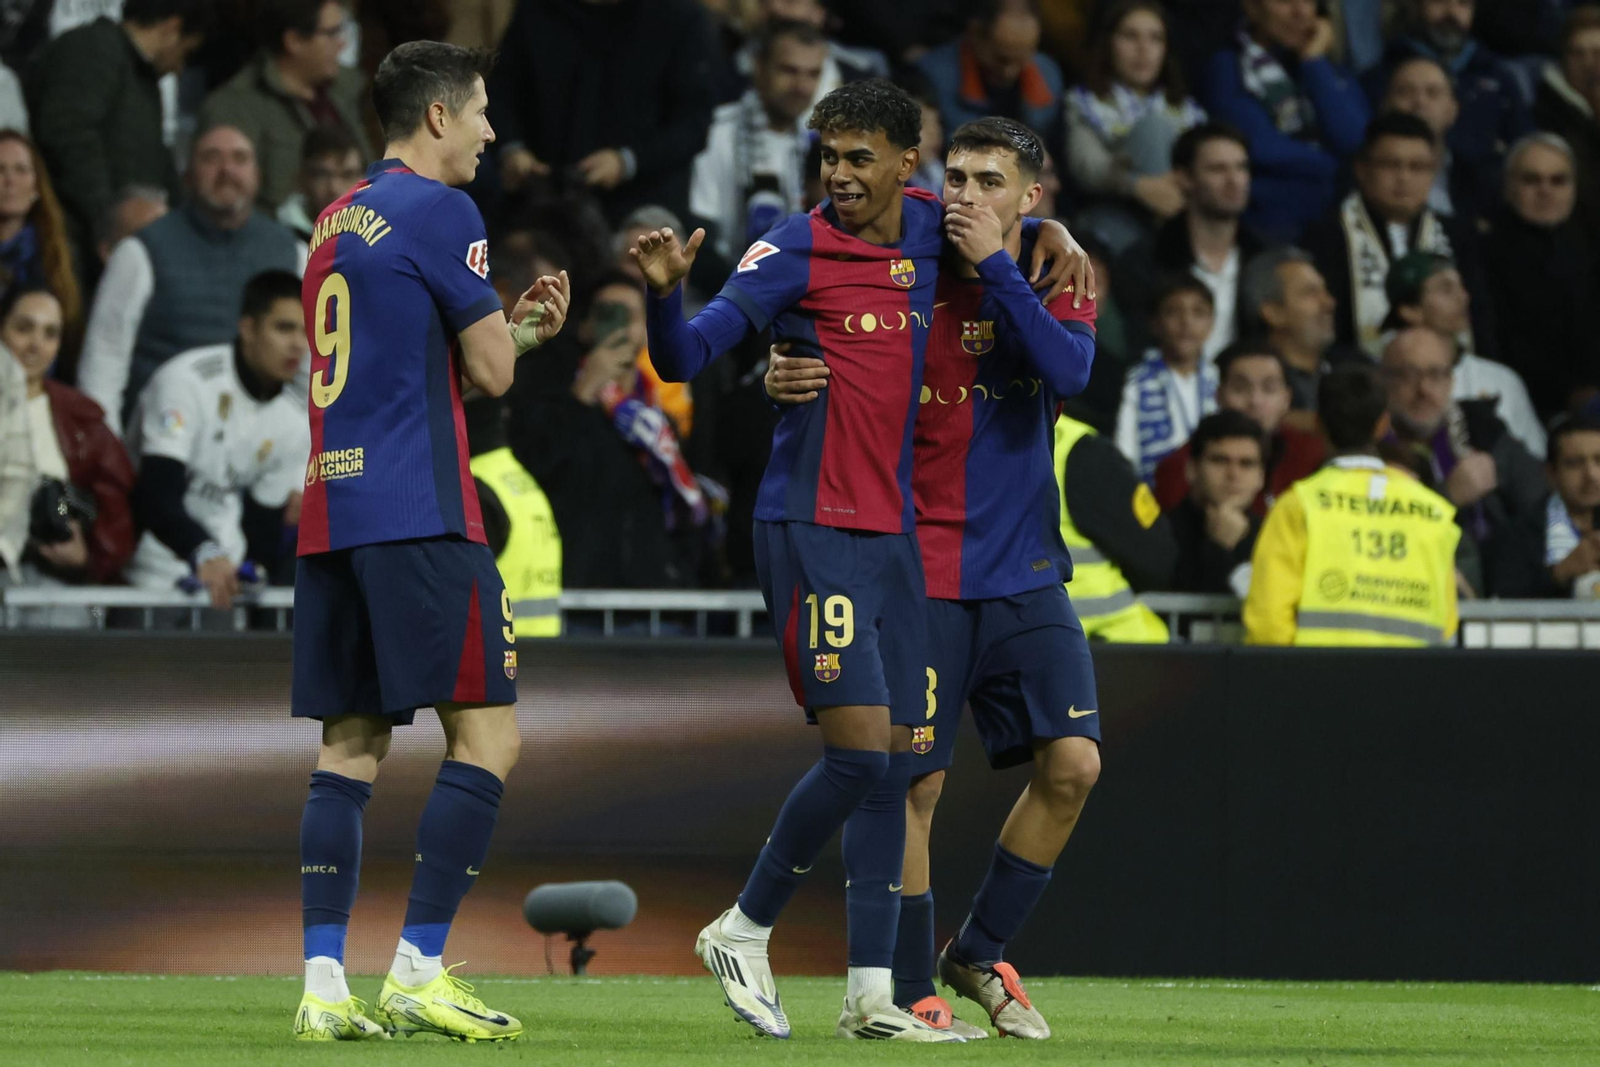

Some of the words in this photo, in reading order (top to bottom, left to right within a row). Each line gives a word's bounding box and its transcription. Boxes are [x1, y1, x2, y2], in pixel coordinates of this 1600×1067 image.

[311, 271, 351, 408] 9
[319, 447, 364, 465] UNHCR
[320, 459, 364, 477] ACNUR
[1351, 528, 1408, 561] 138
[805, 593, 854, 649] 19
